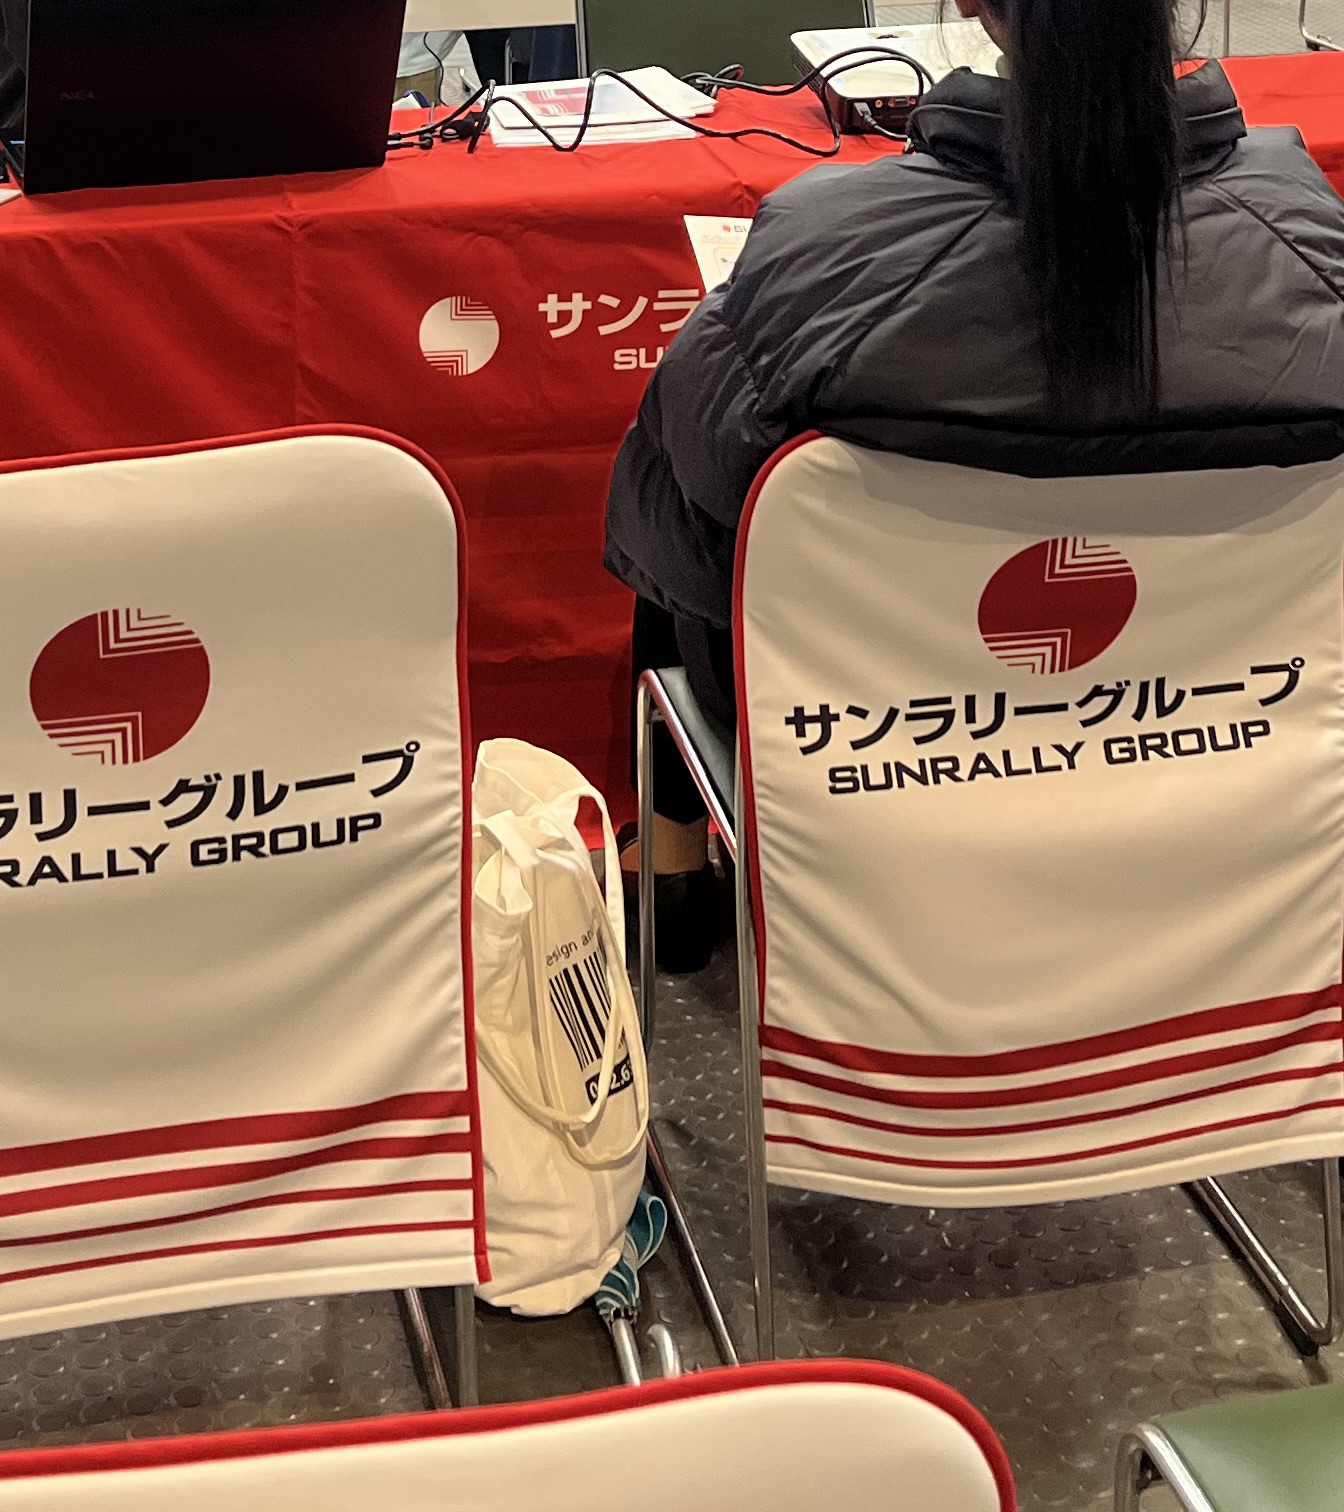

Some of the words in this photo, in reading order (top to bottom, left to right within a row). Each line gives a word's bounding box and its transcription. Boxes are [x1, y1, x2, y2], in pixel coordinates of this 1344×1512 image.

[784, 656, 1306, 756] サンラリーグループ
[828, 740, 1086, 795] SUNRALLY
[1104, 719, 1271, 766] GROUP
[190, 811, 382, 867] GROUP
